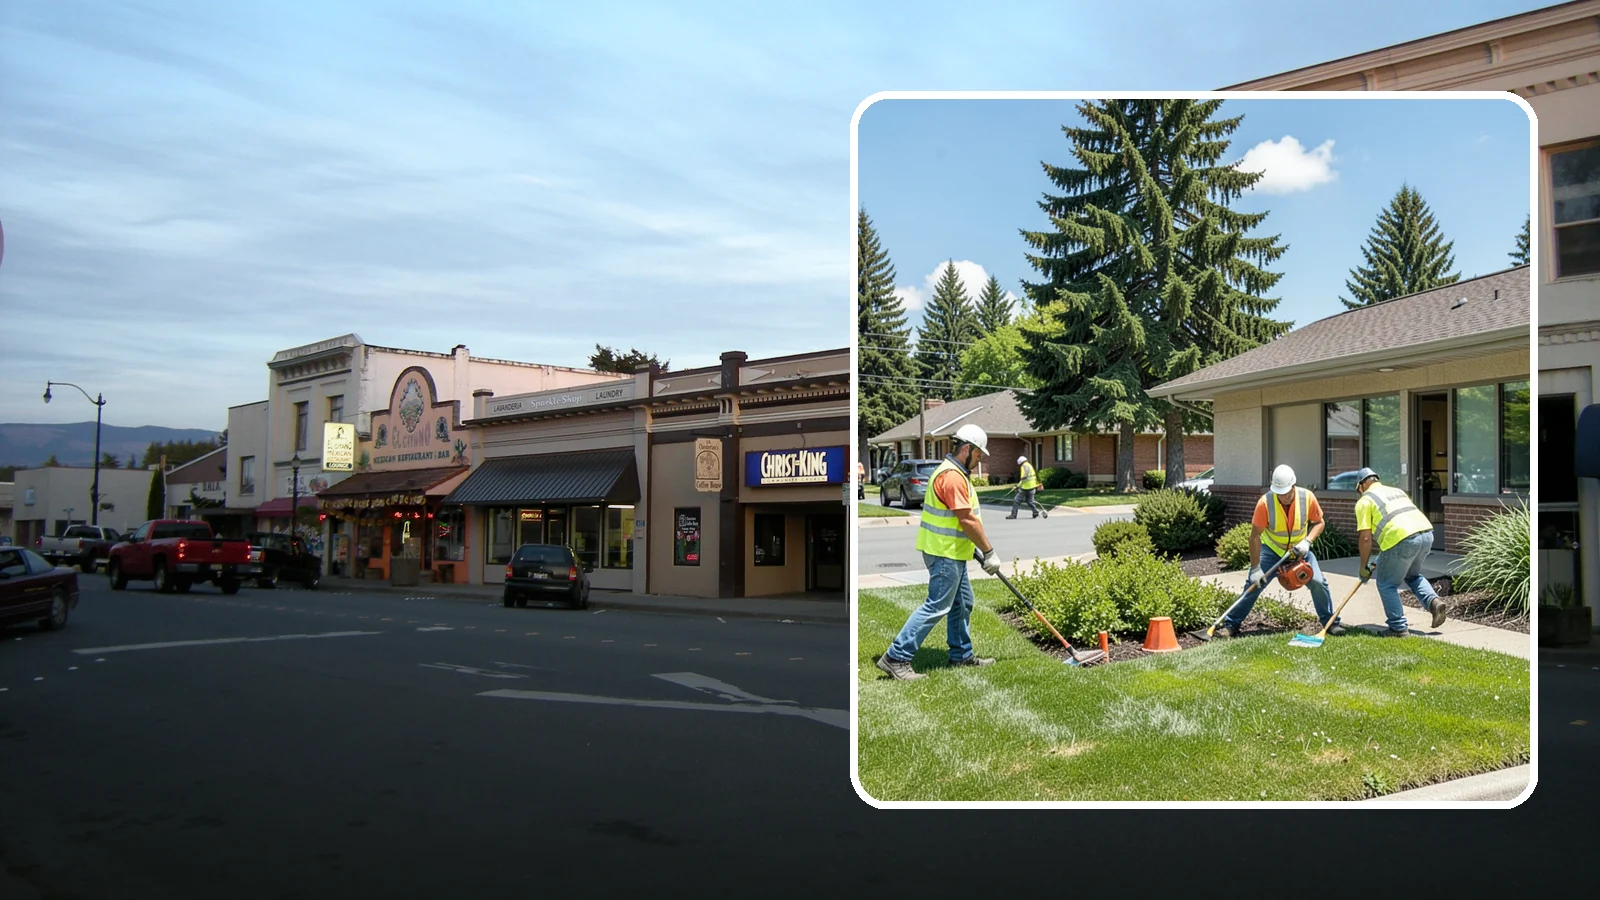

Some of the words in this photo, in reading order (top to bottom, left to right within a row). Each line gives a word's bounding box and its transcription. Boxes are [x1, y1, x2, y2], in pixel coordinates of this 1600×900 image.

[494, 402, 523, 413] LAVANDERIA
[531, 396, 561, 409] Sparkle
[561, 394, 582, 405] Shop
[595, 389, 624, 400] LAUNDRY
[392, 425, 402, 449] EL
[374, 455, 396, 464] MEXICAN
[397, 451, 433, 463] RESTAURANT
[438, 450, 450, 459] BAR
[761, 452, 797, 478] CHRIST
[800, 450, 827, 477] KING
